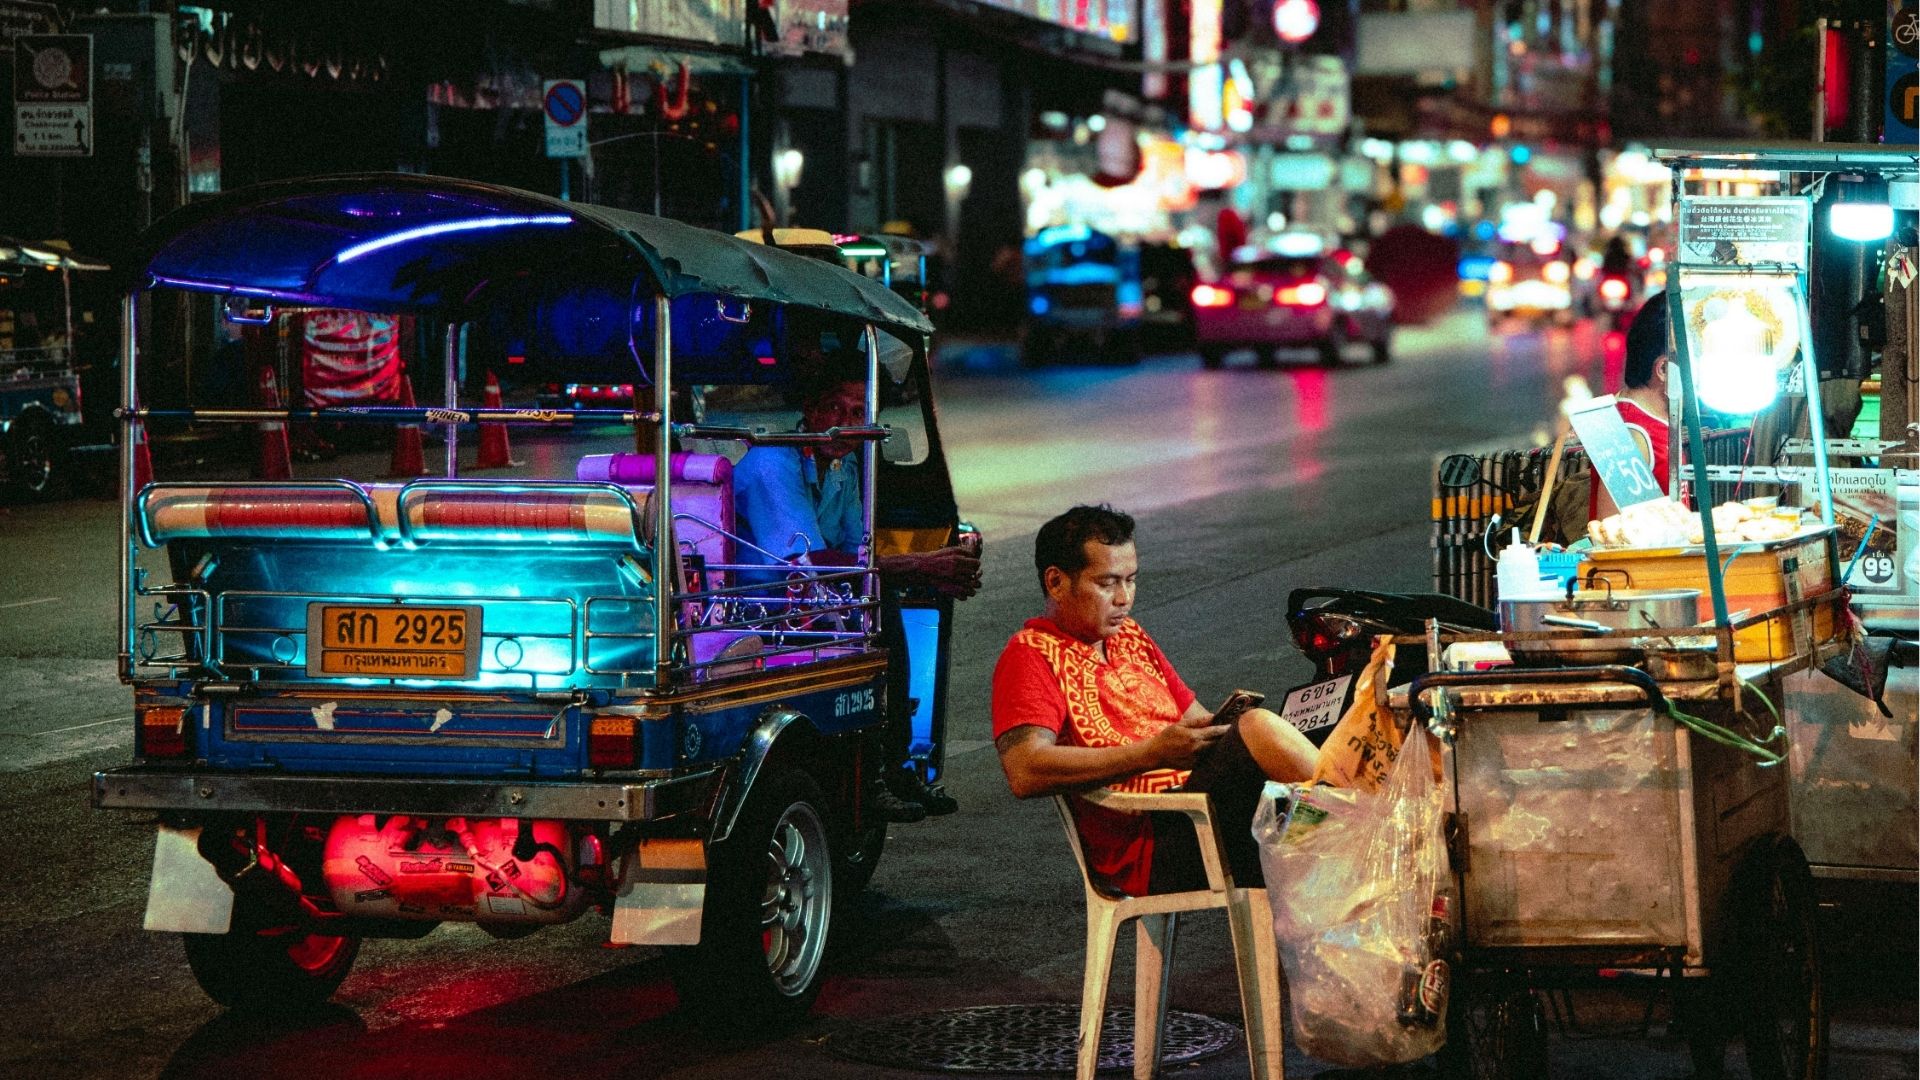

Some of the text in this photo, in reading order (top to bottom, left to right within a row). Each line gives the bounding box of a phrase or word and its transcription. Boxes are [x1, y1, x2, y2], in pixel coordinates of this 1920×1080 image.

[1864, 557, 1892, 577] 99
[337, 611, 464, 644] สก 2925
[343, 653, 447, 671] กรุงเทพมหานคร
[835, 689, 874, 717] สก 2925
[1290, 711, 1330, 732] 284
